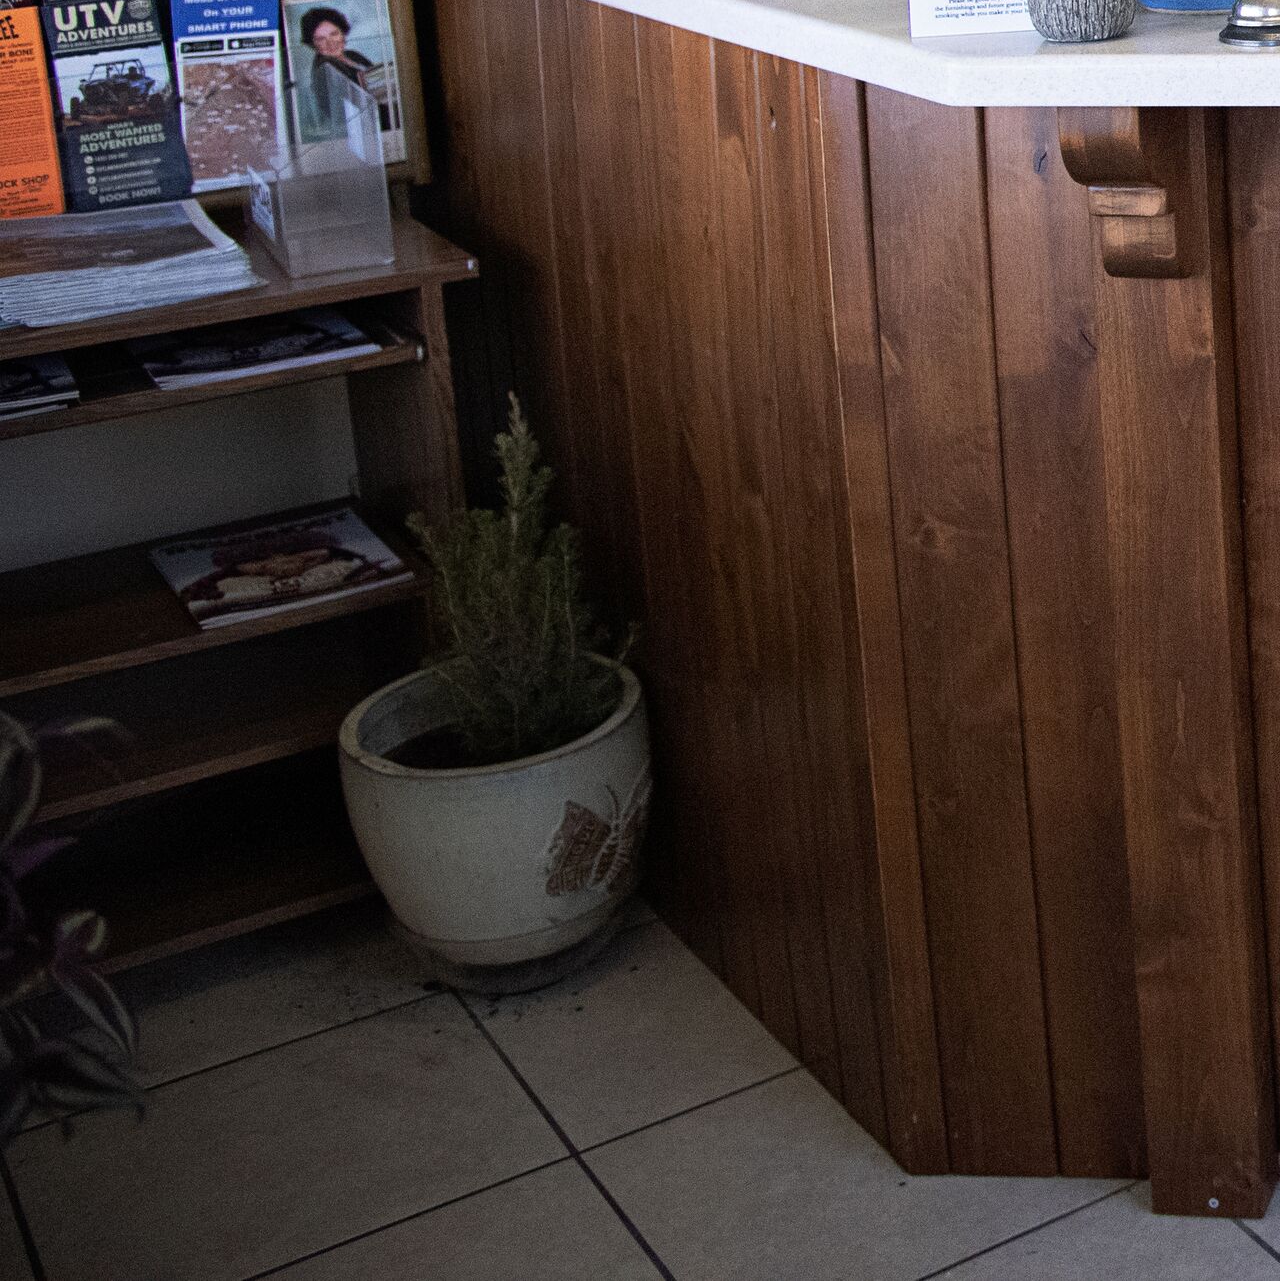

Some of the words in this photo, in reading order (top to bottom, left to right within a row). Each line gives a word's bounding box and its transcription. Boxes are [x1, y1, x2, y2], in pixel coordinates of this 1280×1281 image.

[53, 0, 126, 32] UTV
[222, 5, 254, 18] YOUR
[935, 12, 959, 20] smoking
[56, 20, 155, 45] ADVENTURES
[187, 23, 227, 34] SMART
[230, 19, 269, 32] PHONE
[80, 130, 111, 143] MOST
[114, 123, 163, 139] WANTED
[80, 132, 166, 154] ADVENTURES
[21, 174, 50, 186] SHOP
[98, 193, 129, 204] BOOK
